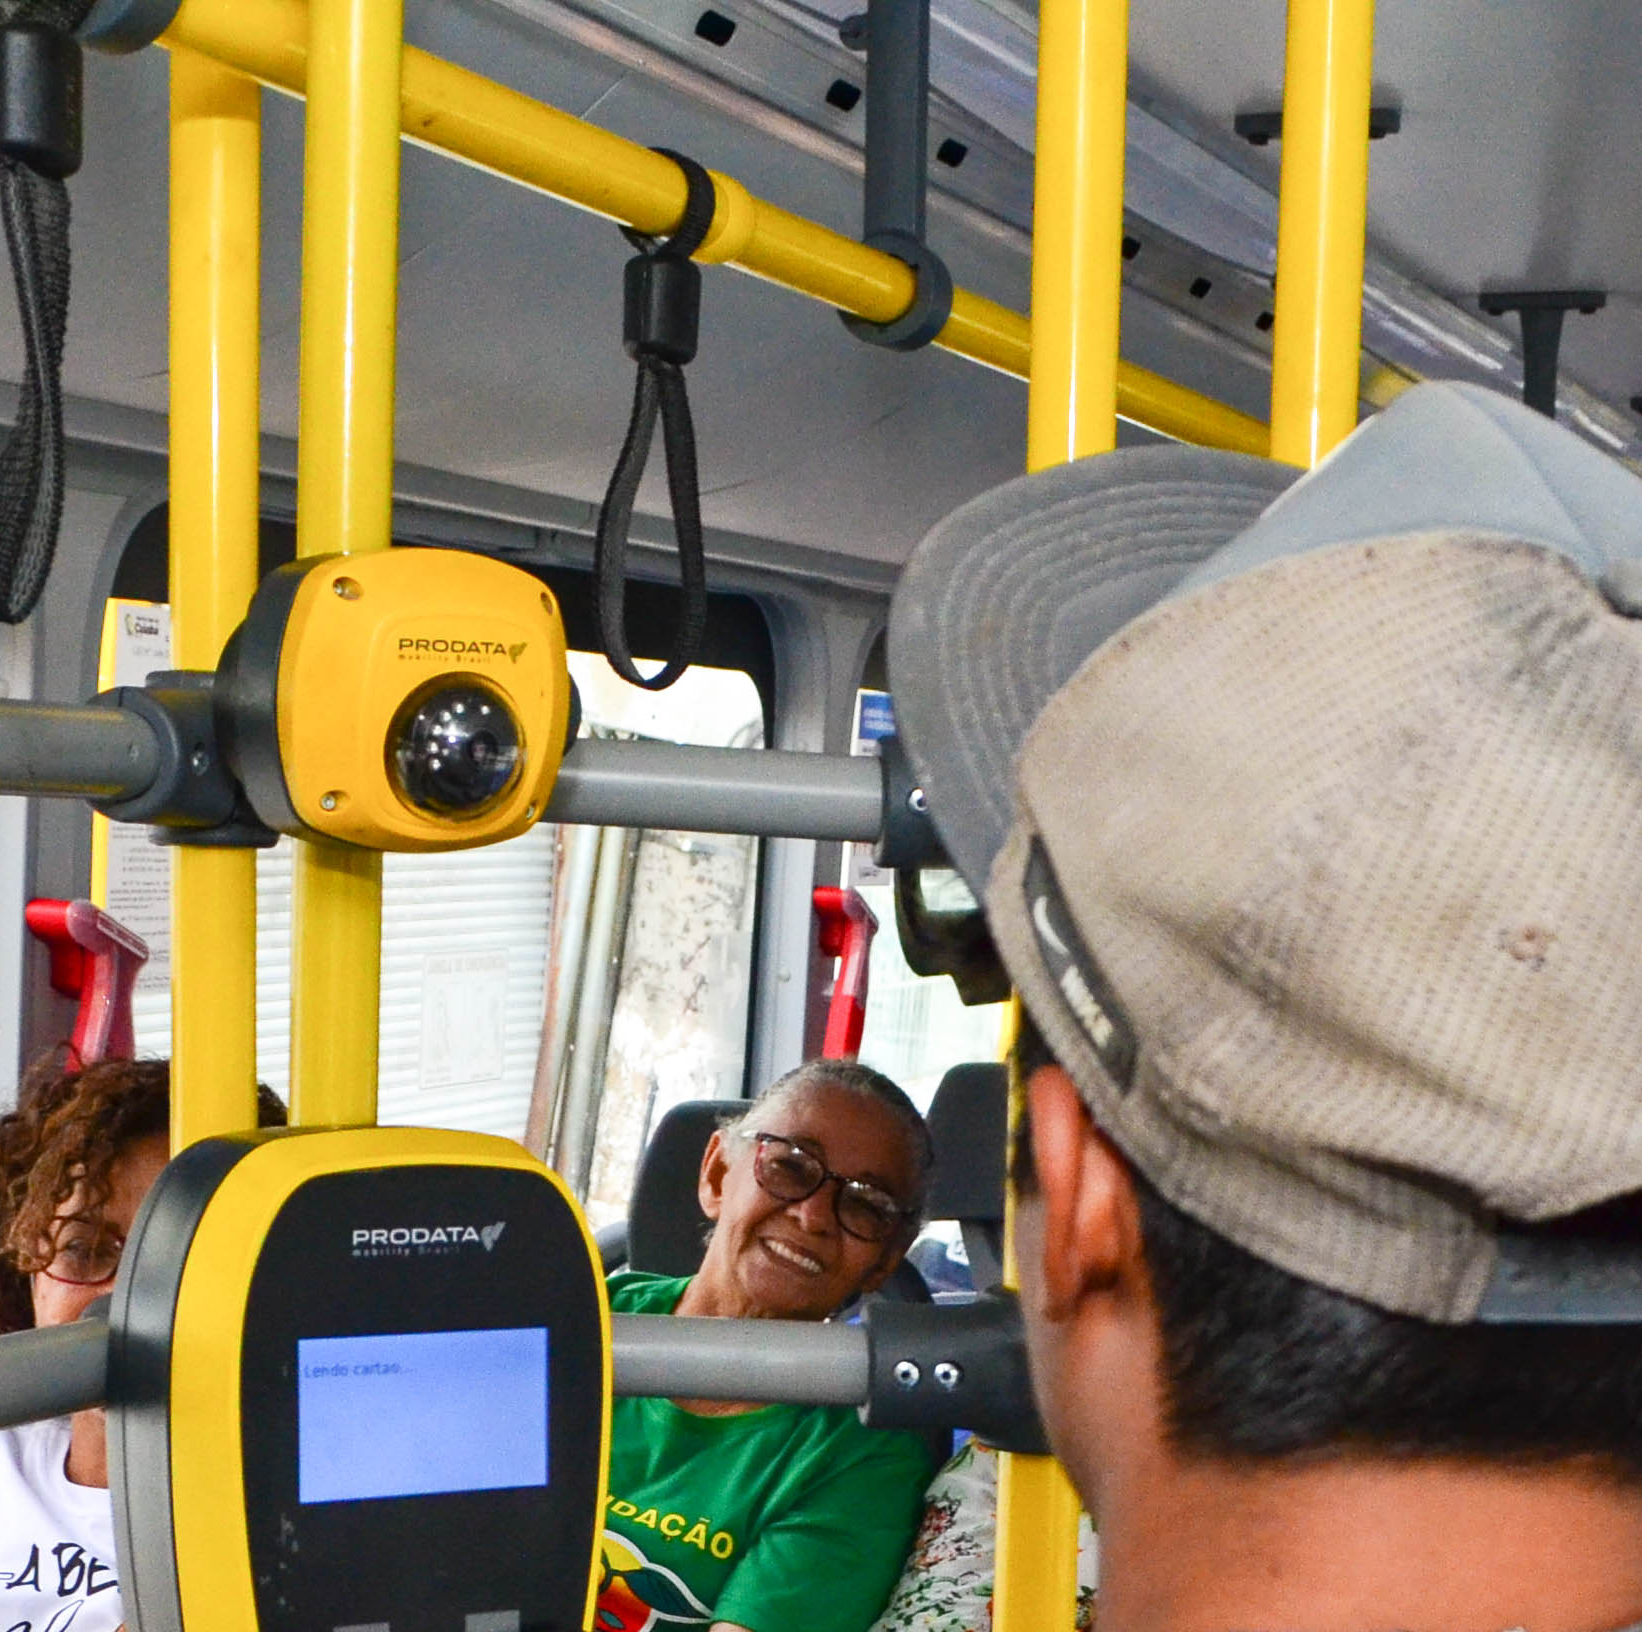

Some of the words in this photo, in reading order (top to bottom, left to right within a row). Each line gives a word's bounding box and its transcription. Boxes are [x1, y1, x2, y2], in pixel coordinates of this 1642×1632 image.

[399, 638, 507, 655] PRODATA
[352, 1226, 479, 1246] PRODATA
[604, 1495, 734, 1560] DAÇÃO
[51, 1542, 121, 1597] BE
